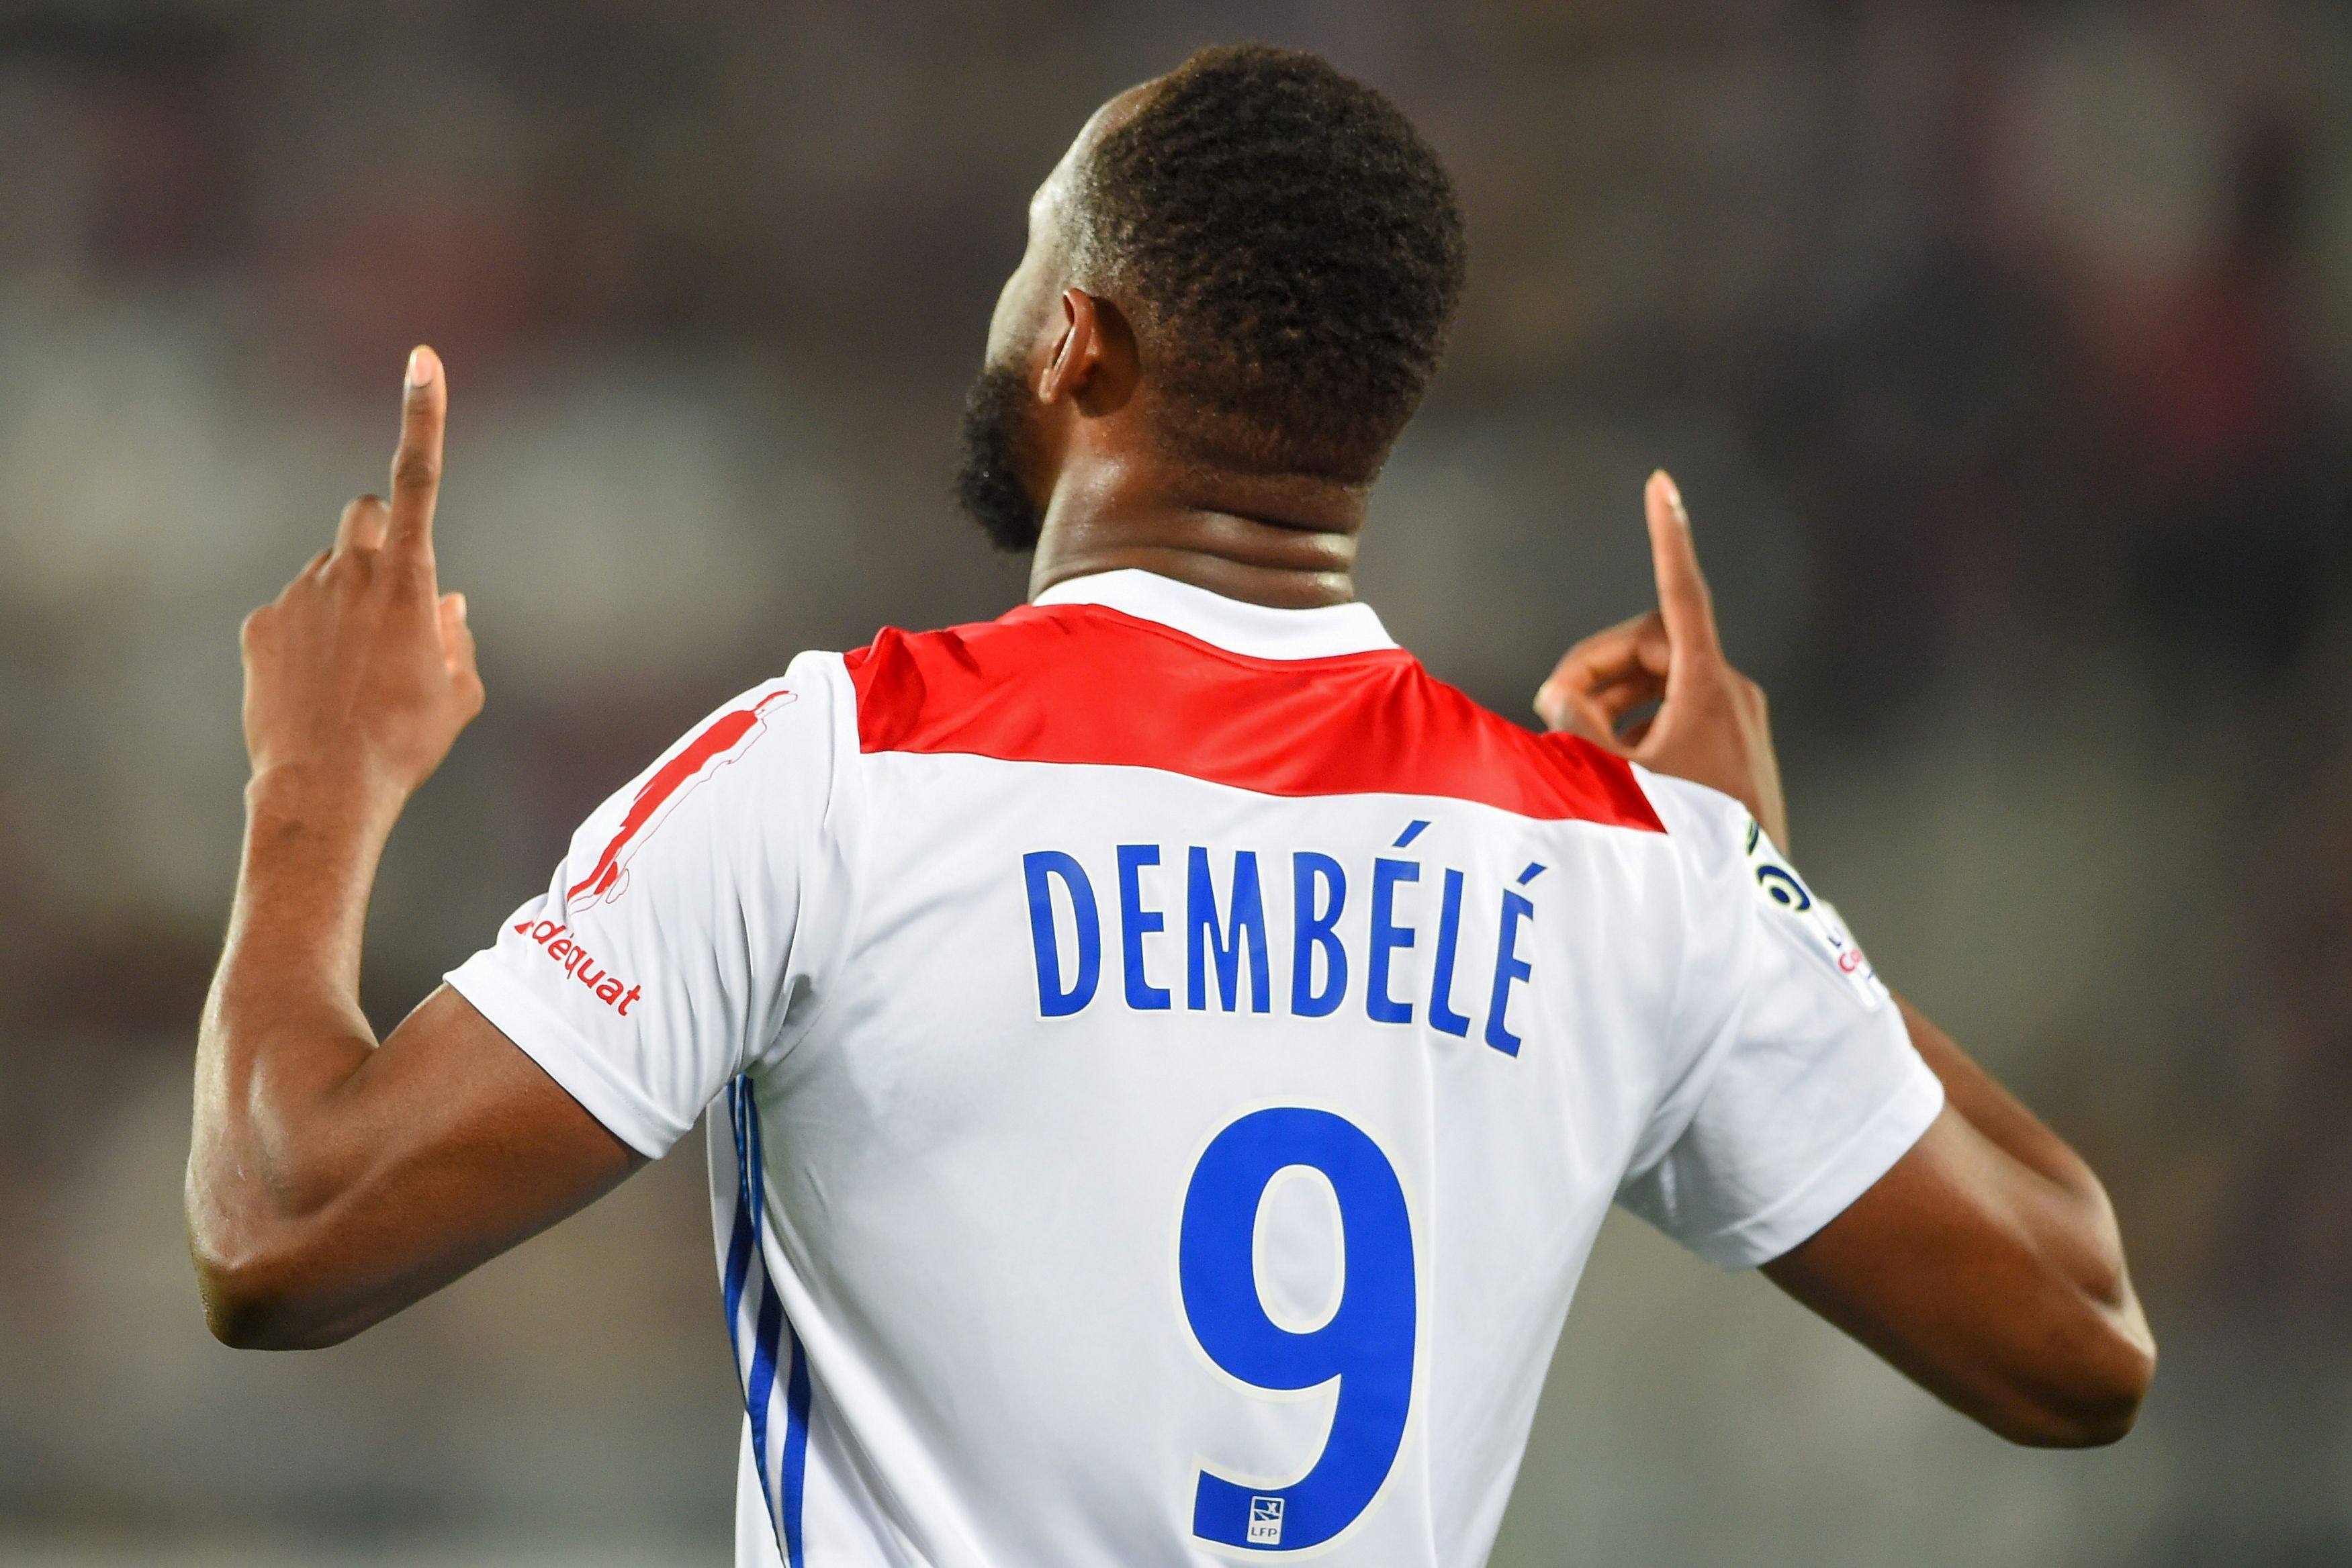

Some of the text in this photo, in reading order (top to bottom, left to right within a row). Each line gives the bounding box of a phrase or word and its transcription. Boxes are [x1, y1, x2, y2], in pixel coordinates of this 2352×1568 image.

[1023, 820, 1545, 1057] DEMBÉLÉ
[1179, 1107, 1417, 1551] 9
[1251, 1527, 1277, 1537] LFP
